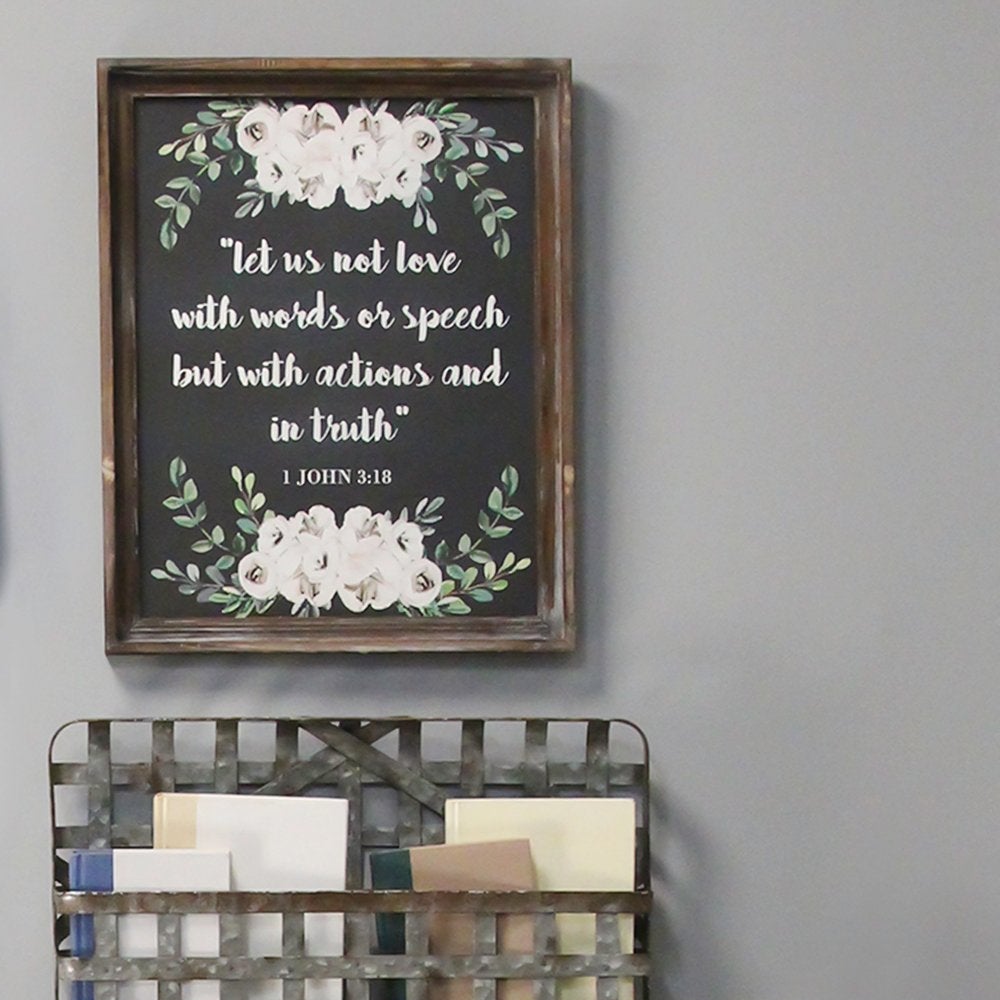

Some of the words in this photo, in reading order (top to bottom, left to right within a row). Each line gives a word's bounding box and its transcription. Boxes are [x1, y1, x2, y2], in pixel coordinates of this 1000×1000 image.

[284, 249, 324, 274] us
[333, 238, 389, 274] not
[396, 240, 462, 274] love
[171, 294, 244, 329] with
[250, 291, 349, 329] words
[358, 301, 395, 329] or
[403, 295, 510, 342] speech
[173, 352, 230, 388] but
[237, 352, 309, 387] with
[316, 352, 433, 387] actions
[442, 348, 509, 387] and
[270, 416, 304, 442] in
[282, 469, 290, 485] 1
[297, 469, 352, 485] JOHN
[358, 469, 392, 485] 3:18
